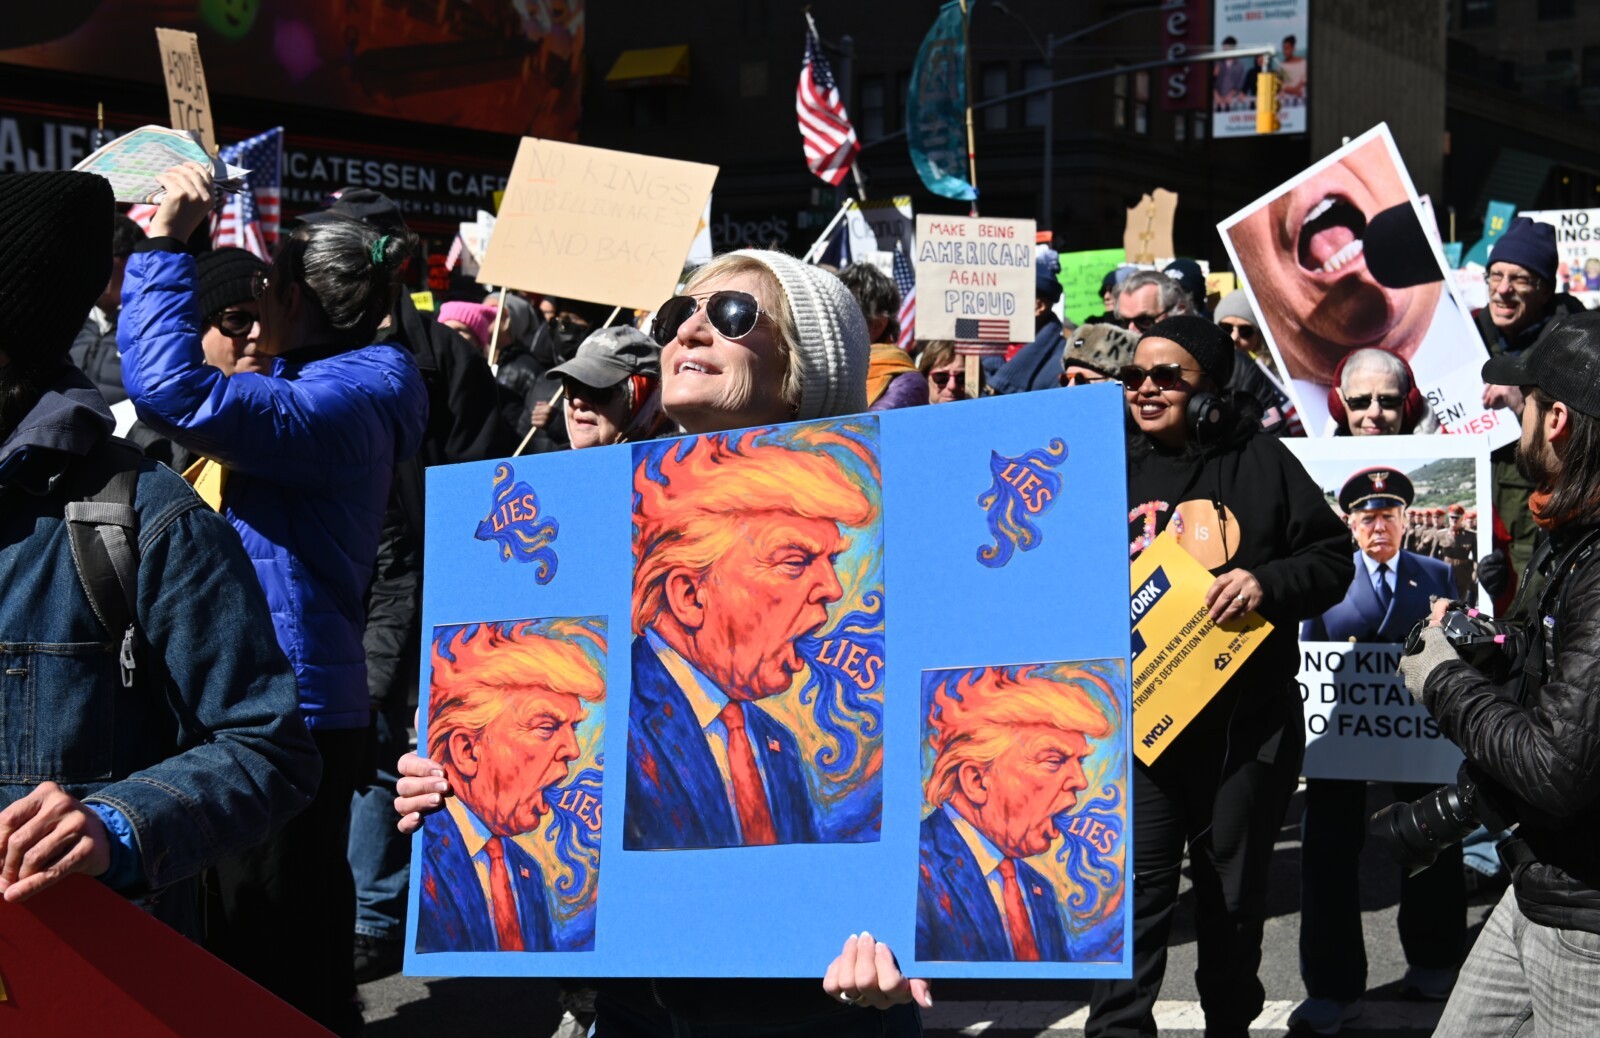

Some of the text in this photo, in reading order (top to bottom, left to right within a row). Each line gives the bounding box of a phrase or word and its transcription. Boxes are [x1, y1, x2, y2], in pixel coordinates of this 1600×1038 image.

[529, 147, 693, 205] NO KINGS
[433, 202, 482, 219] DINNE
[1561, 212, 1589, 226] NO
[930, 223, 1014, 239] MAKE BEING
[1558, 228, 1600, 242] INGS
[594, 237, 667, 268] BACK
[919, 240, 1030, 268] AMERICAN
[1567, 248, 1587, 256] YES
[949, 269, 997, 286] AGAIN
[945, 290, 1015, 316] PROUD
[1000, 462, 1053, 514] LIES
[491, 494, 537, 533] LIES
[1195, 523, 1209, 540] is
[1228, 637, 1240, 649] NEW
[1232, 643, 1243, 653] FOR
[815, 639, 884, 690] LIES
[1132, 650, 1169, 690] IMMIGRANT
[1165, 635, 1183, 653] NEW
[1133, 677, 1163, 707] TRUMP'S
[1159, 634, 1202, 680] DEPORTATION
[1305, 652, 1345, 673] NO
[1141, 714, 1174, 749] NYCLU
[1338, 715, 1447, 739] FASCIS
[558, 790, 602, 831] LIES
[1068, 817, 1118, 854] LIES
